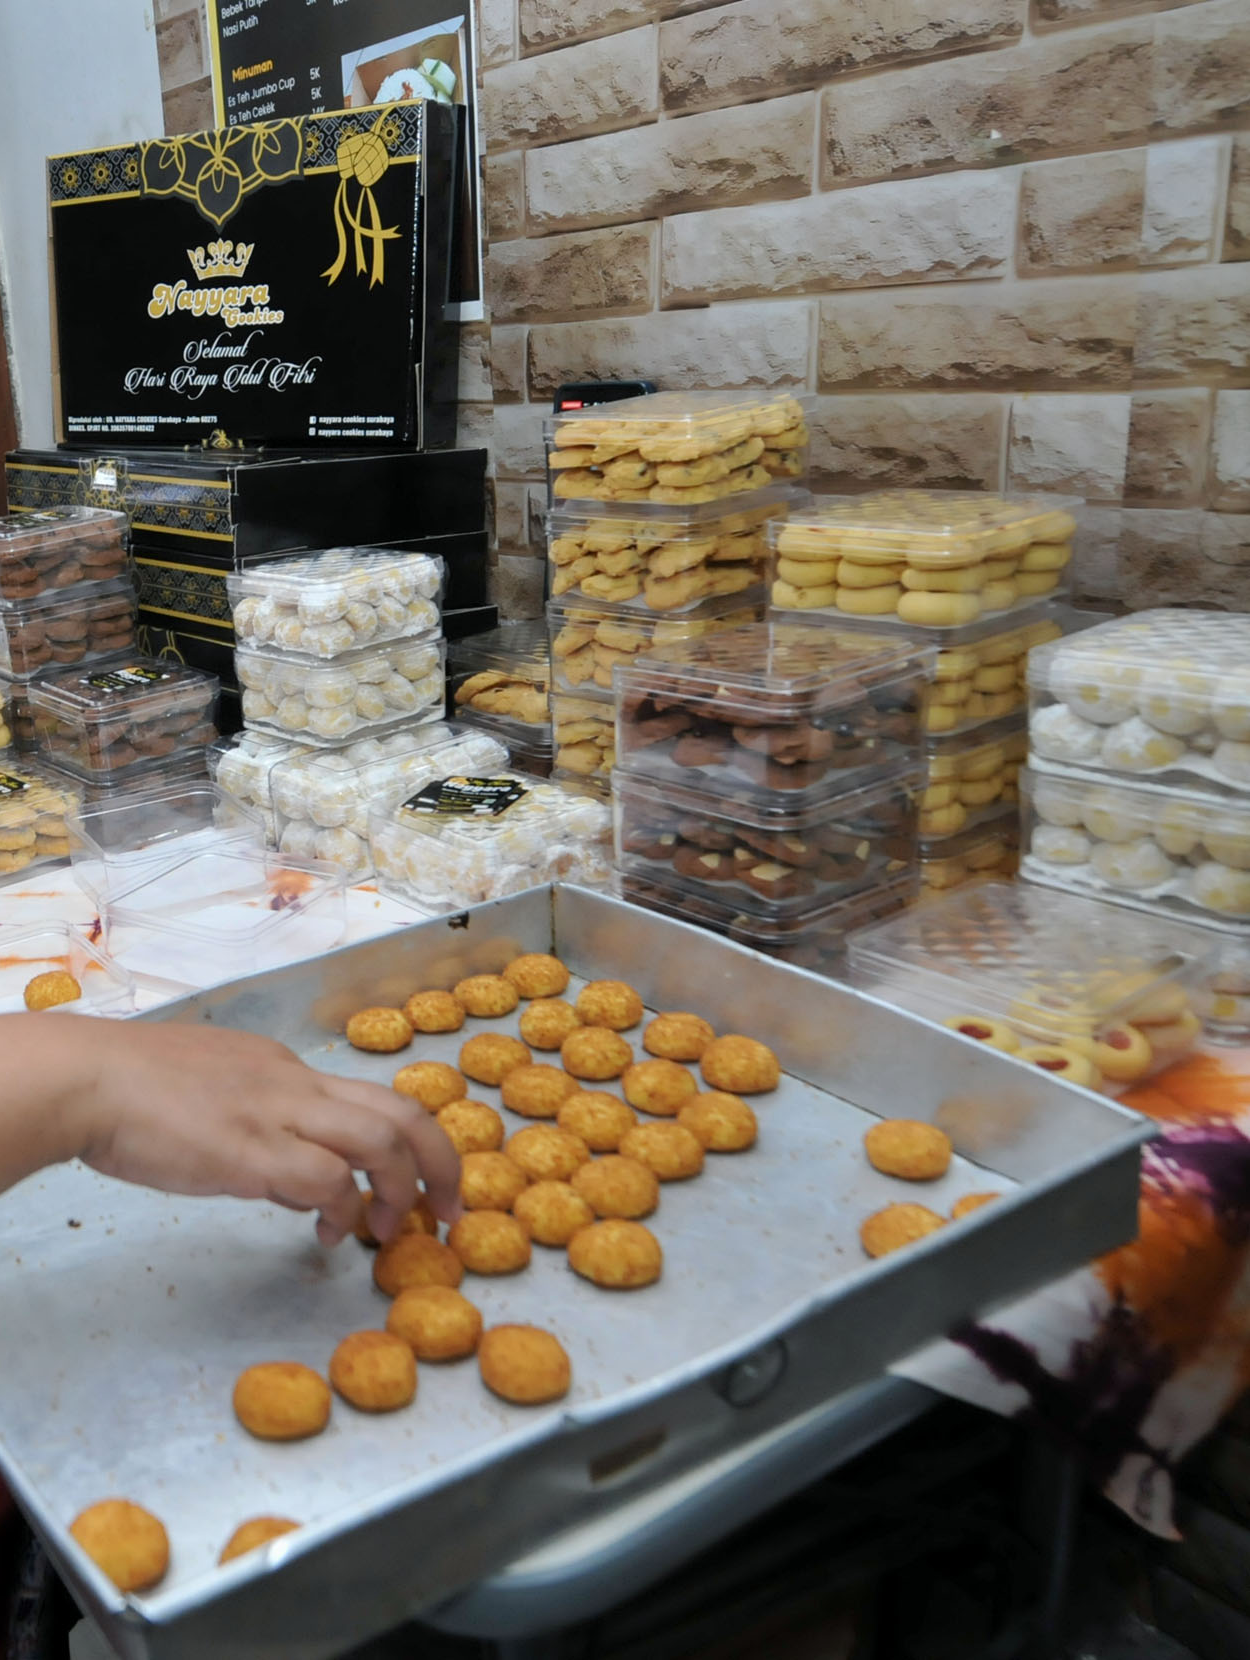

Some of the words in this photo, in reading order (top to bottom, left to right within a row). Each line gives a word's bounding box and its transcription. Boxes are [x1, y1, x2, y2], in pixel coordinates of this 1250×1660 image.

[221, 2, 243, 19] Bebek
[223, 21, 239, 37] Nasi
[239, 15, 259, 31] Putih
[232, 60, 273, 82] Minuman
[228, 96, 237, 107] Es
[237, 92, 251, 104] Teh
[251, 82, 278, 100] Jumbo
[278, 77, 296, 91] Cup
[310, 66, 321, 80] 5K
[230, 114, 238, 125] Es
[238, 110, 252, 122] Teh
[311, 86, 322, 100] 5K
[148, 279, 270, 319] Nayyara
[220, 306, 284, 328] Cookies
[183, 330, 264, 363] Selamat
[123, 367, 167, 395] Hari
[169, 365, 219, 400] Raya
[222, 357, 281, 393] Idul
[268, 356, 323, 393] Fitri
[158, 416, 182, 424] Surabaya
[319, 416, 342, 425] nayyara
[343, 415, 365, 423] cookies
[366, 415, 395, 424] surabaya
[318, 429, 341, 437] nayyara
[342, 428, 364, 436] cookies
[365, 428, 393, 437] surabaya
